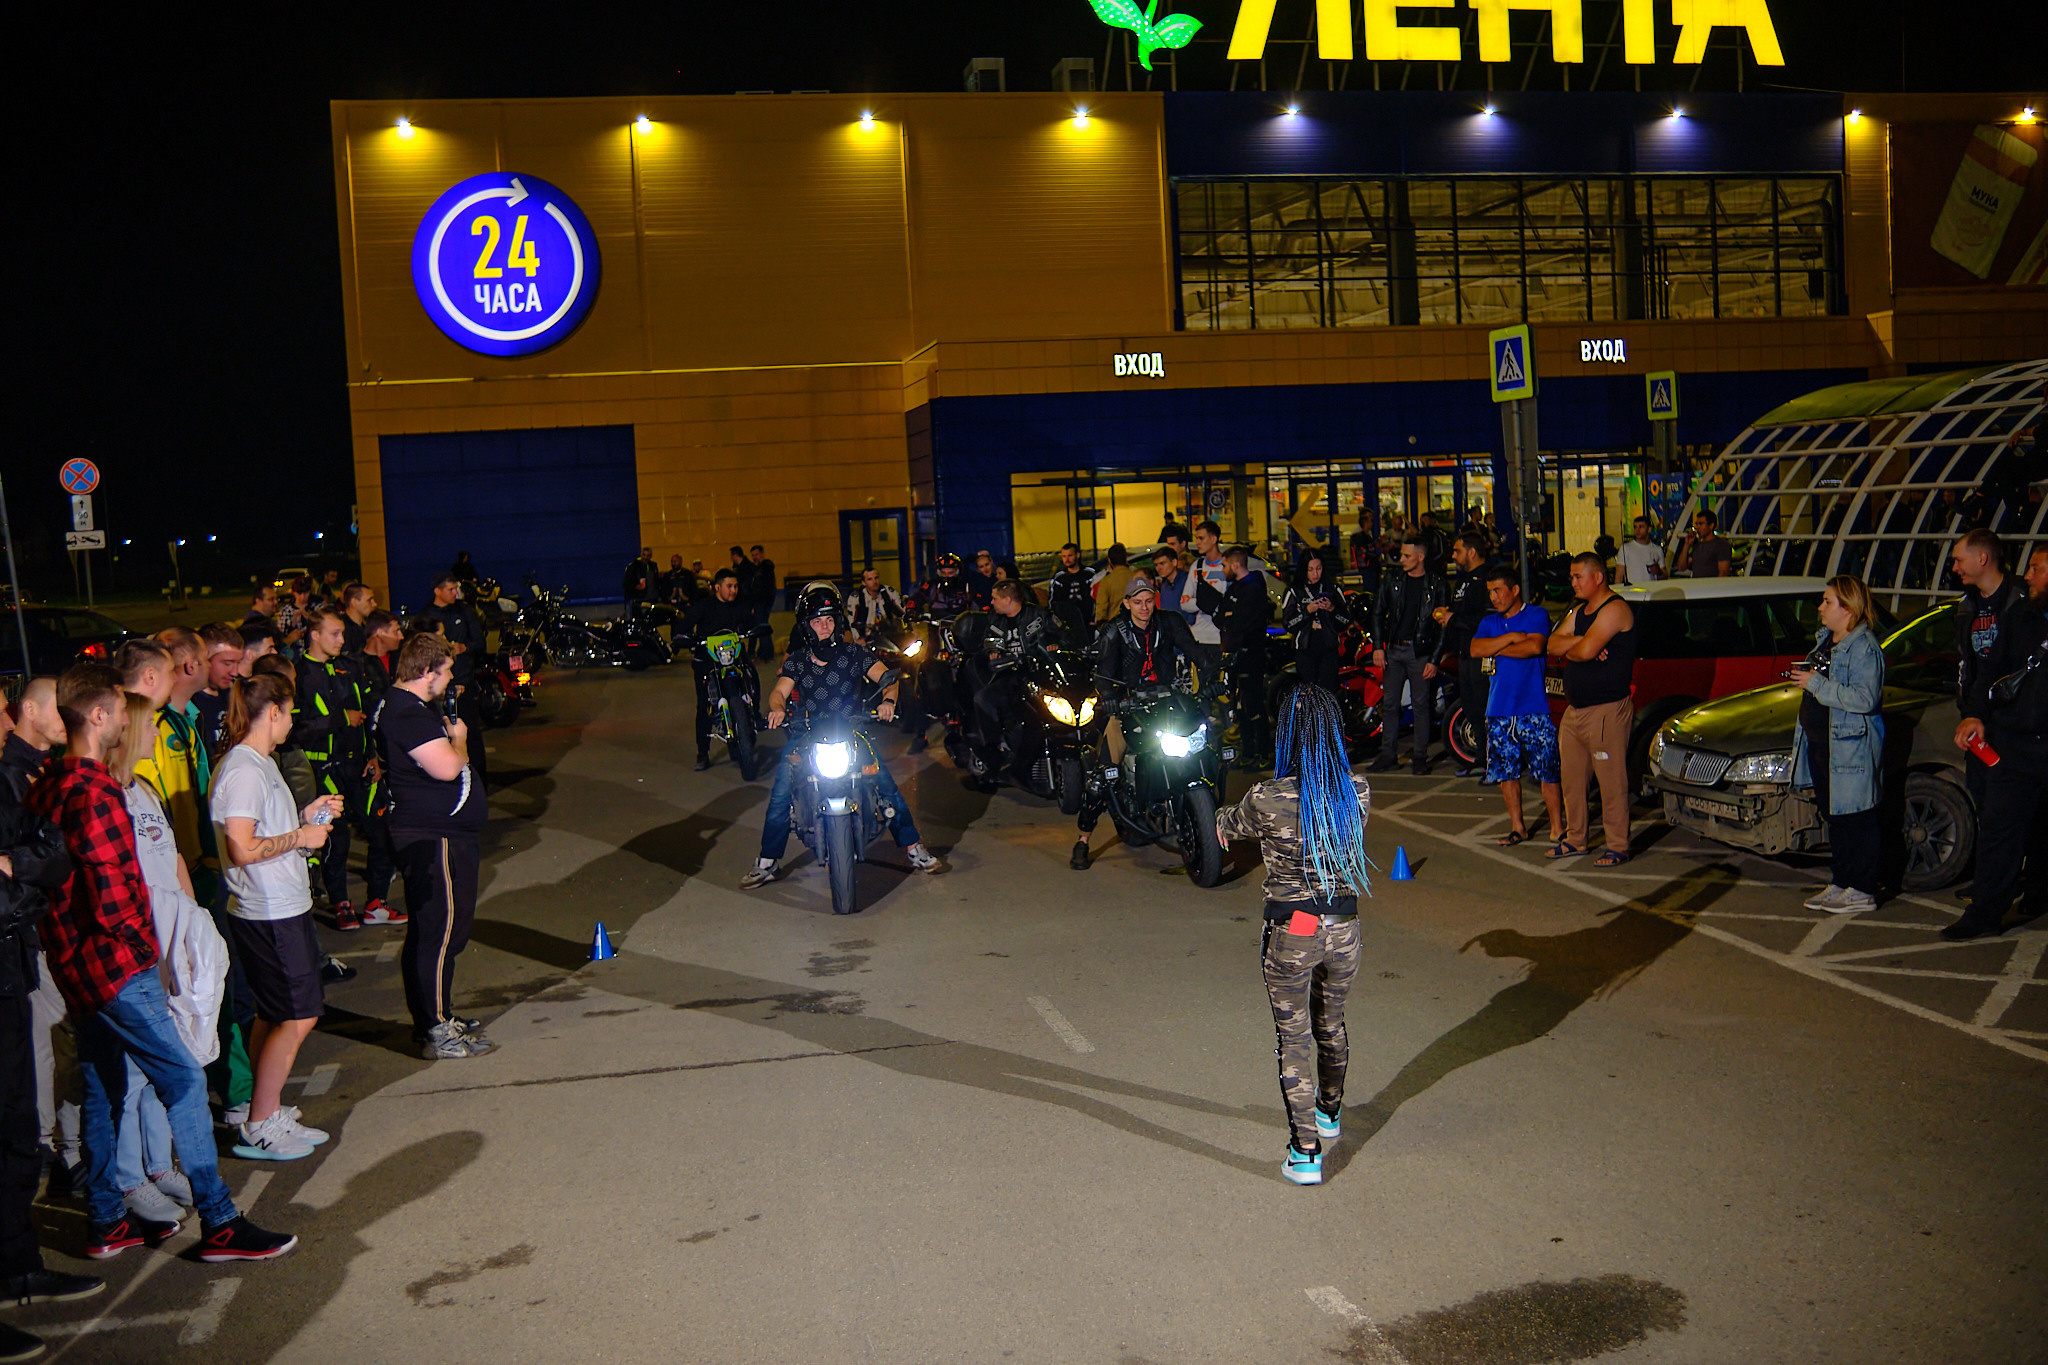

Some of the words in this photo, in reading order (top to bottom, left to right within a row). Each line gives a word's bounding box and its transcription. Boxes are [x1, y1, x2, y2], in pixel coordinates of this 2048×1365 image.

[1971, 185, 1999, 209] МУКА
[471, 215, 540, 278] 24
[474, 282, 543, 314] ЧАСА
[1580, 338, 1627, 363] ВХОД
[1113, 352, 1165, 378] ВХОД
